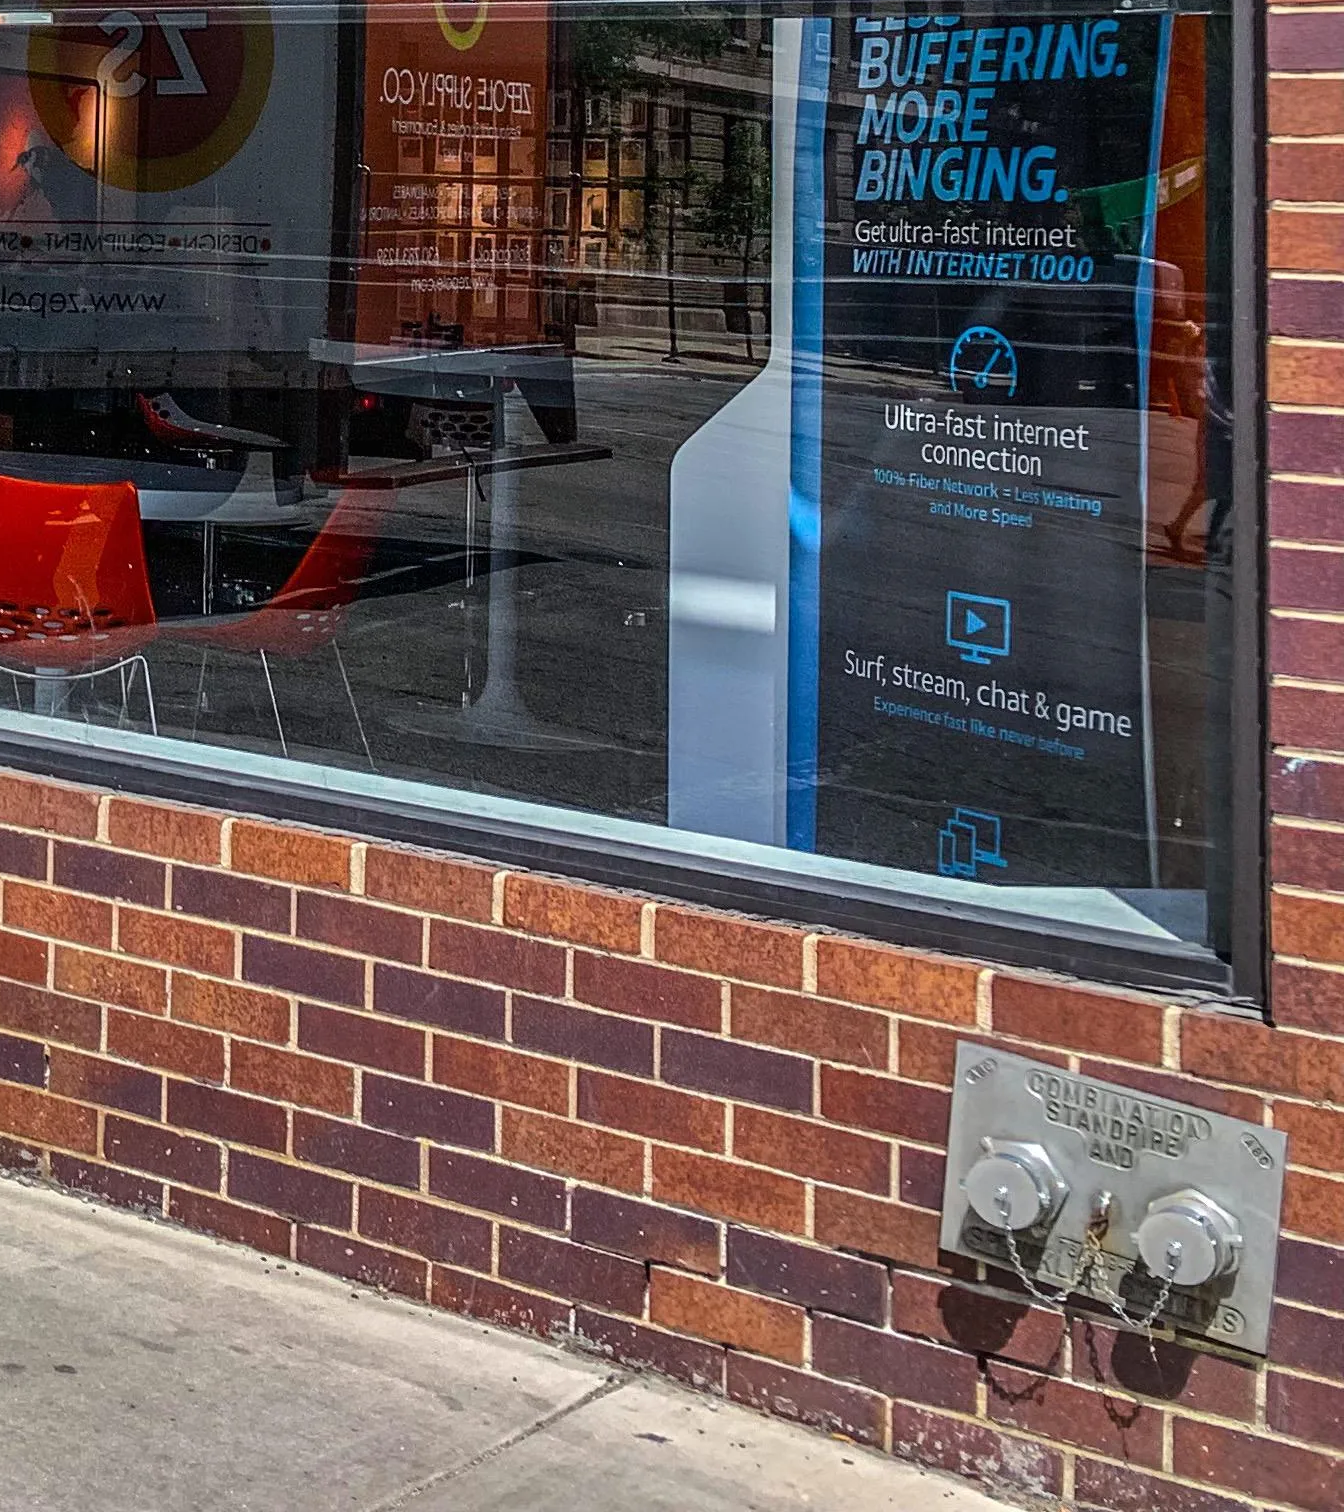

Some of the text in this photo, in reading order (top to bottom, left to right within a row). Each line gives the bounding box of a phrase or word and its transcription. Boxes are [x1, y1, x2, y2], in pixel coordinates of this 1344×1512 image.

[857, 18, 1129, 89] BUFFERING.
[856, 88, 997, 145] MORE
[855, 145, 1069, 204] BINGING.
[855, 218, 1077, 248] Get ultra-fast internet
[852, 248, 1094, 282] WITH INTERNET 1000
[884, 403, 1089, 452] Ultra-fast internet
[920, 441, 1042, 478] connection
[873, 468, 905, 486] 100%
[909, 472, 941, 491] Fiber
[942, 476, 999, 500] Network
[1015, 486, 1041, 505] Less
[1042, 489, 1102, 517] Waiting
[929, 500, 1033, 528] and More Speed
[844, 649, 1132, 738] Surf, stream, chat & game
[873, 696, 943, 726] Experience
[944, 712, 967, 733] fast
[970, 718, 996, 738] like
[1028, 1071, 1209, 1140] COMBINATION
[1045, 1100, 1181, 1159] STANDPIPE
[1087, 1140, 1135, 1169] AND
